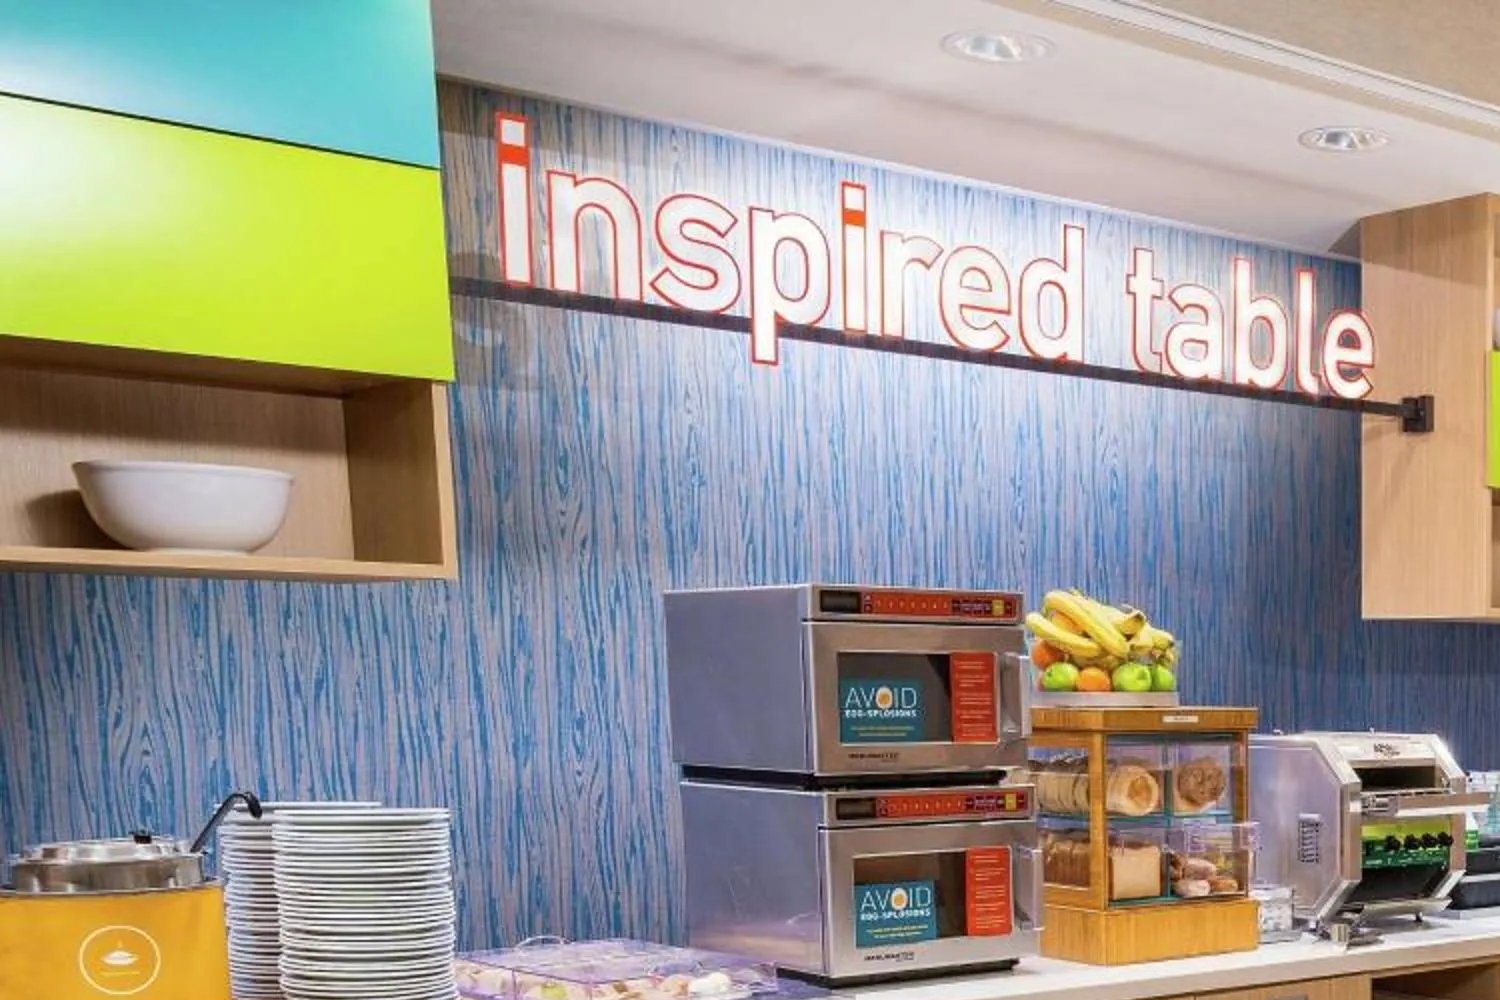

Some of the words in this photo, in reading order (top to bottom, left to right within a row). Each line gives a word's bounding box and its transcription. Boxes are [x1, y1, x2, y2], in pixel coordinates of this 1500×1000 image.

[495, 112, 1085, 366] inspired
[1126, 247, 1375, 399] table
[845, 686, 917, 710] AVOID
[860, 886, 931, 911] AVOID
